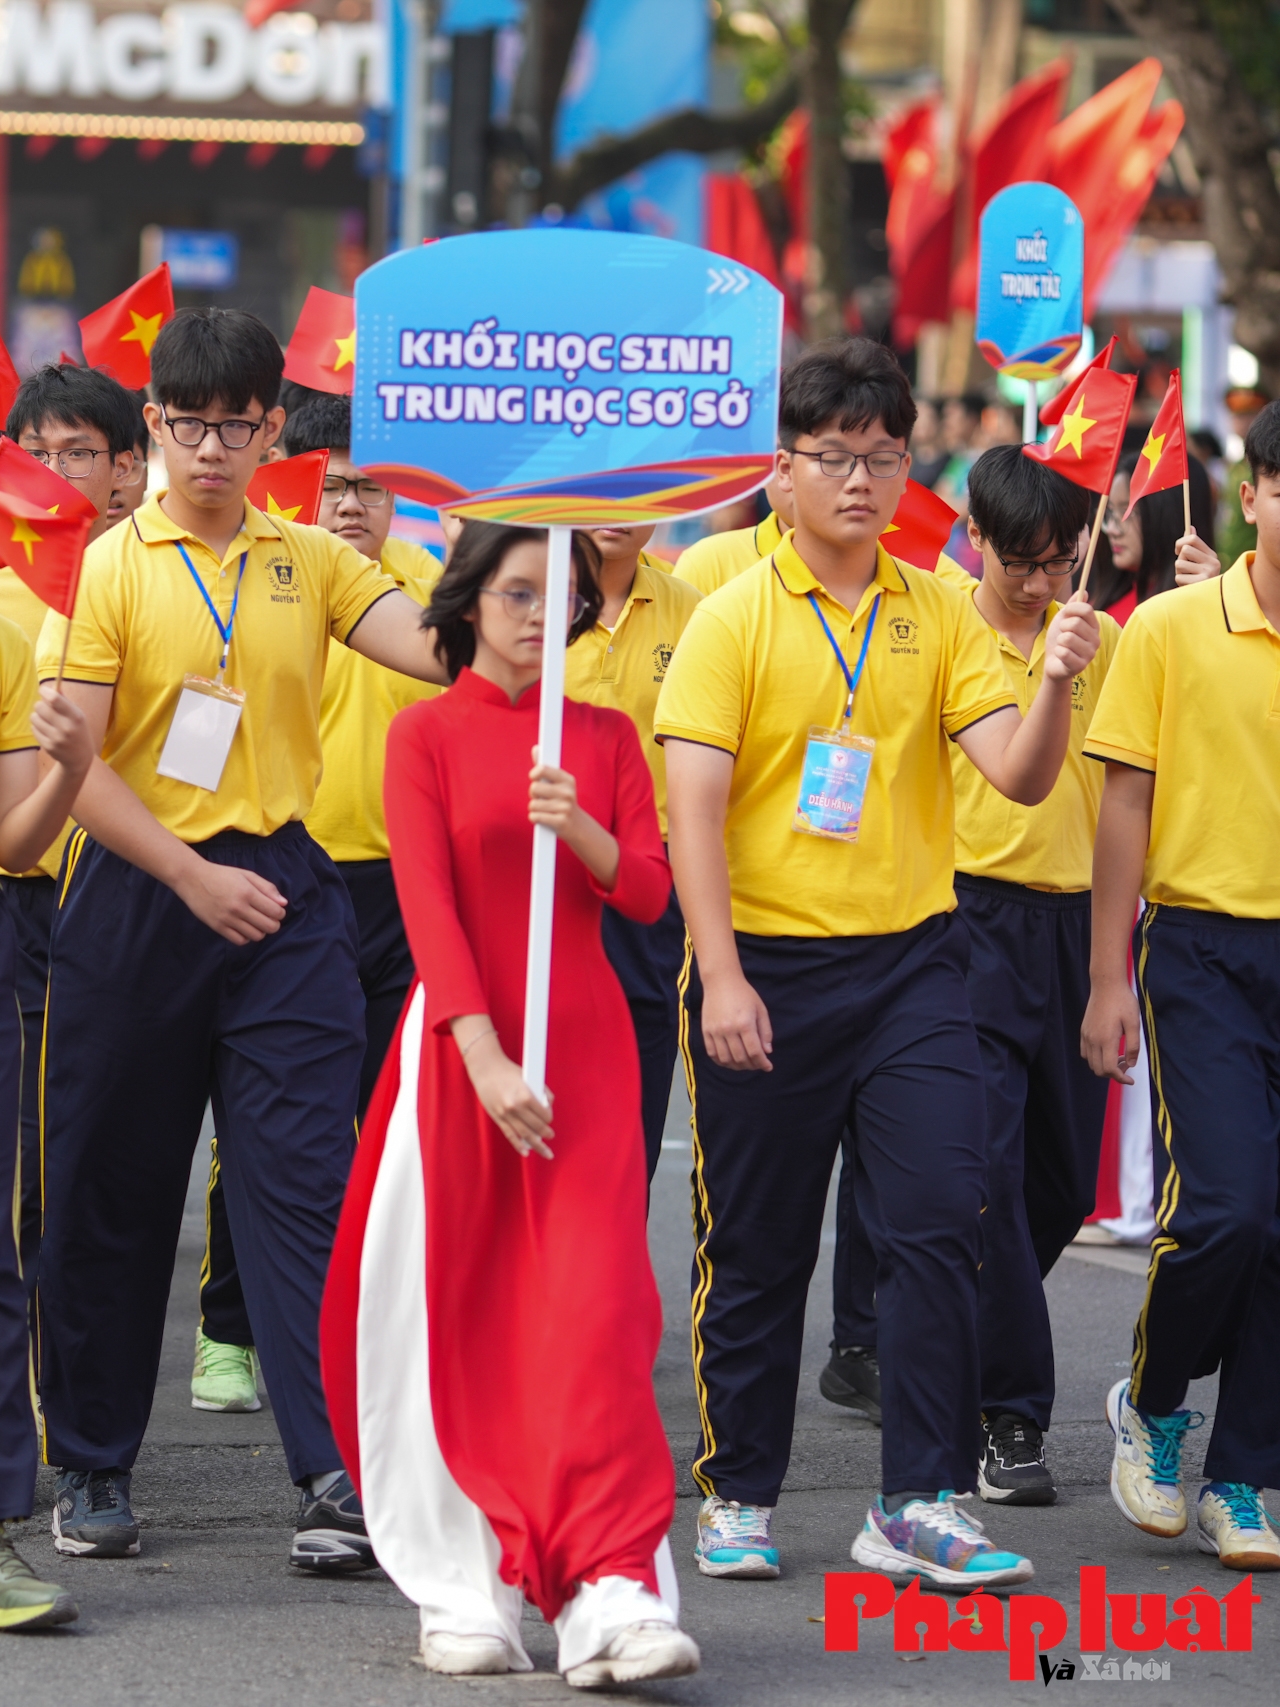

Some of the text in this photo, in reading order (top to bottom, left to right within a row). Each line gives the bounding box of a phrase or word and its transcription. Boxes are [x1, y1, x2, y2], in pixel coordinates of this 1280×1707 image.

[400, 317, 732, 382] KHỐI HỌC SINH
[377, 379, 752, 435] TRUNG HỌC SƠ SỞ
